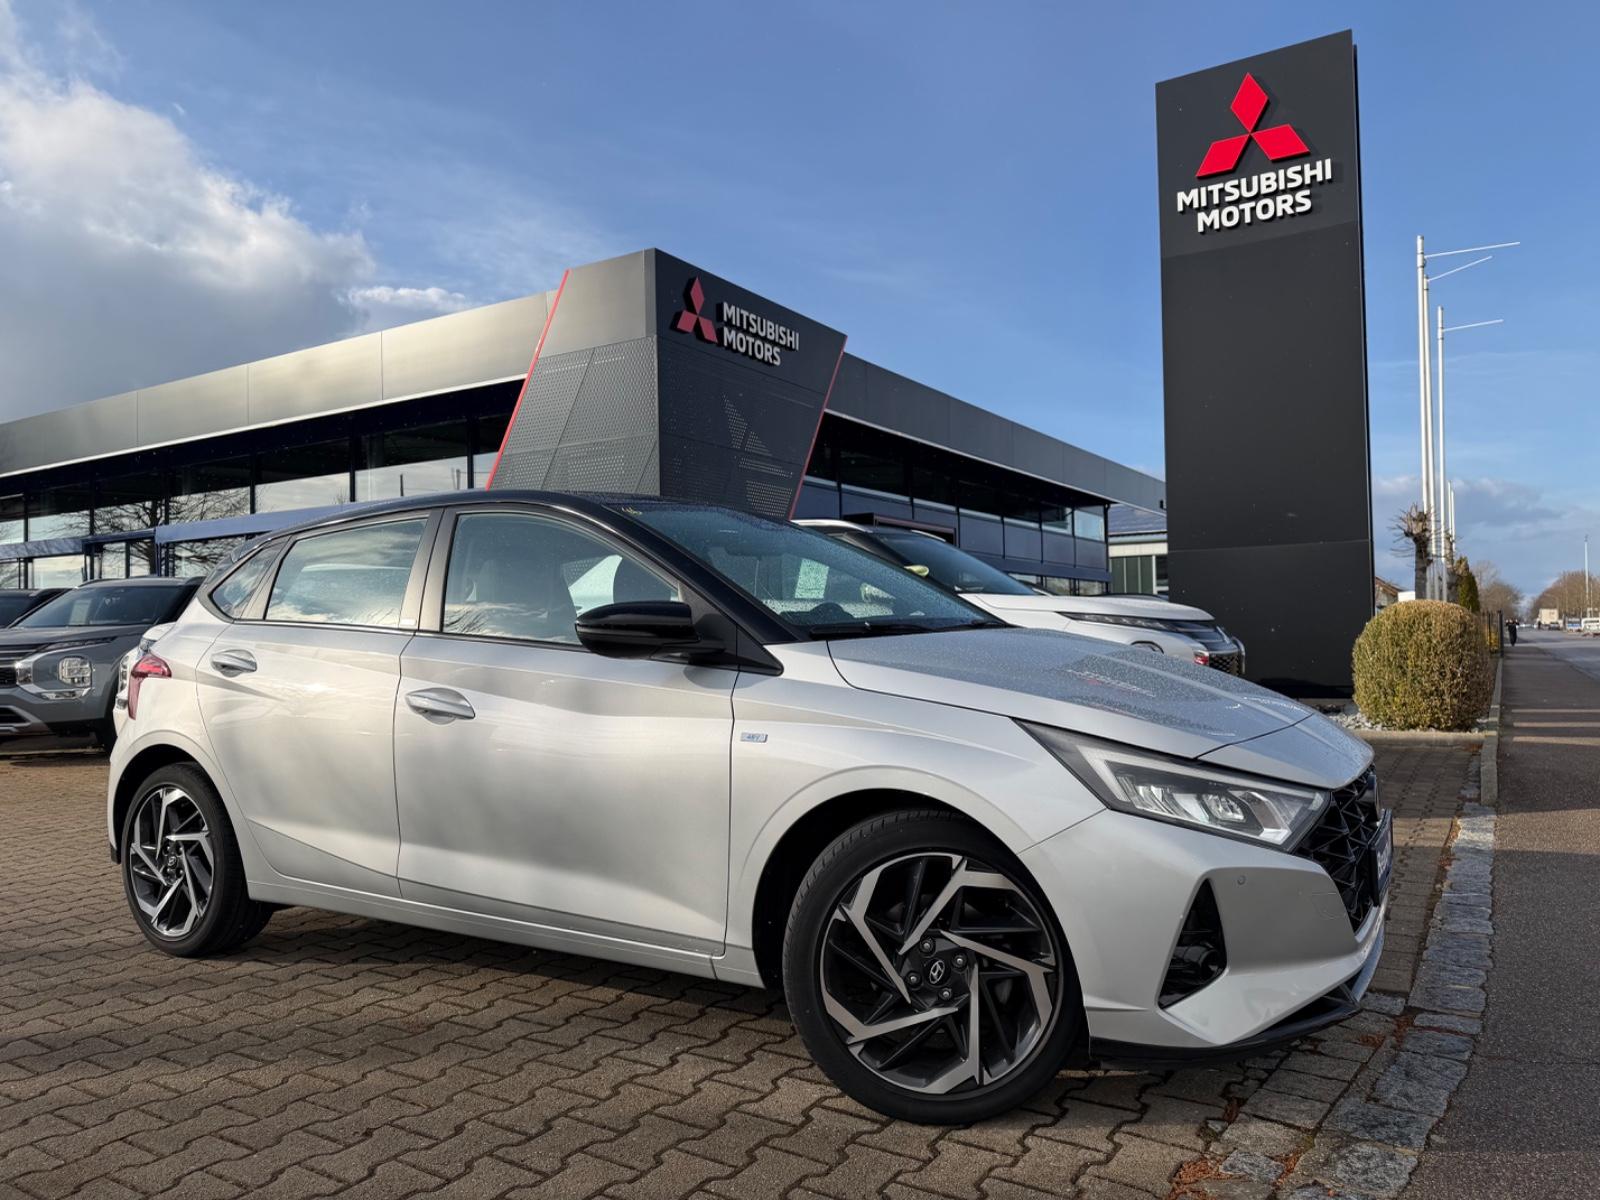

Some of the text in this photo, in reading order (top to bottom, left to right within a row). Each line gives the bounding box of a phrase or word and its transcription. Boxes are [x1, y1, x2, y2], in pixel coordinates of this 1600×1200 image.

[1177, 158, 1332, 212] MITSUBISHI
[1197, 190, 1312, 233] MOTORS
[723, 301, 800, 350] MITSUBISHI
[723, 327, 781, 366] MOTORS
